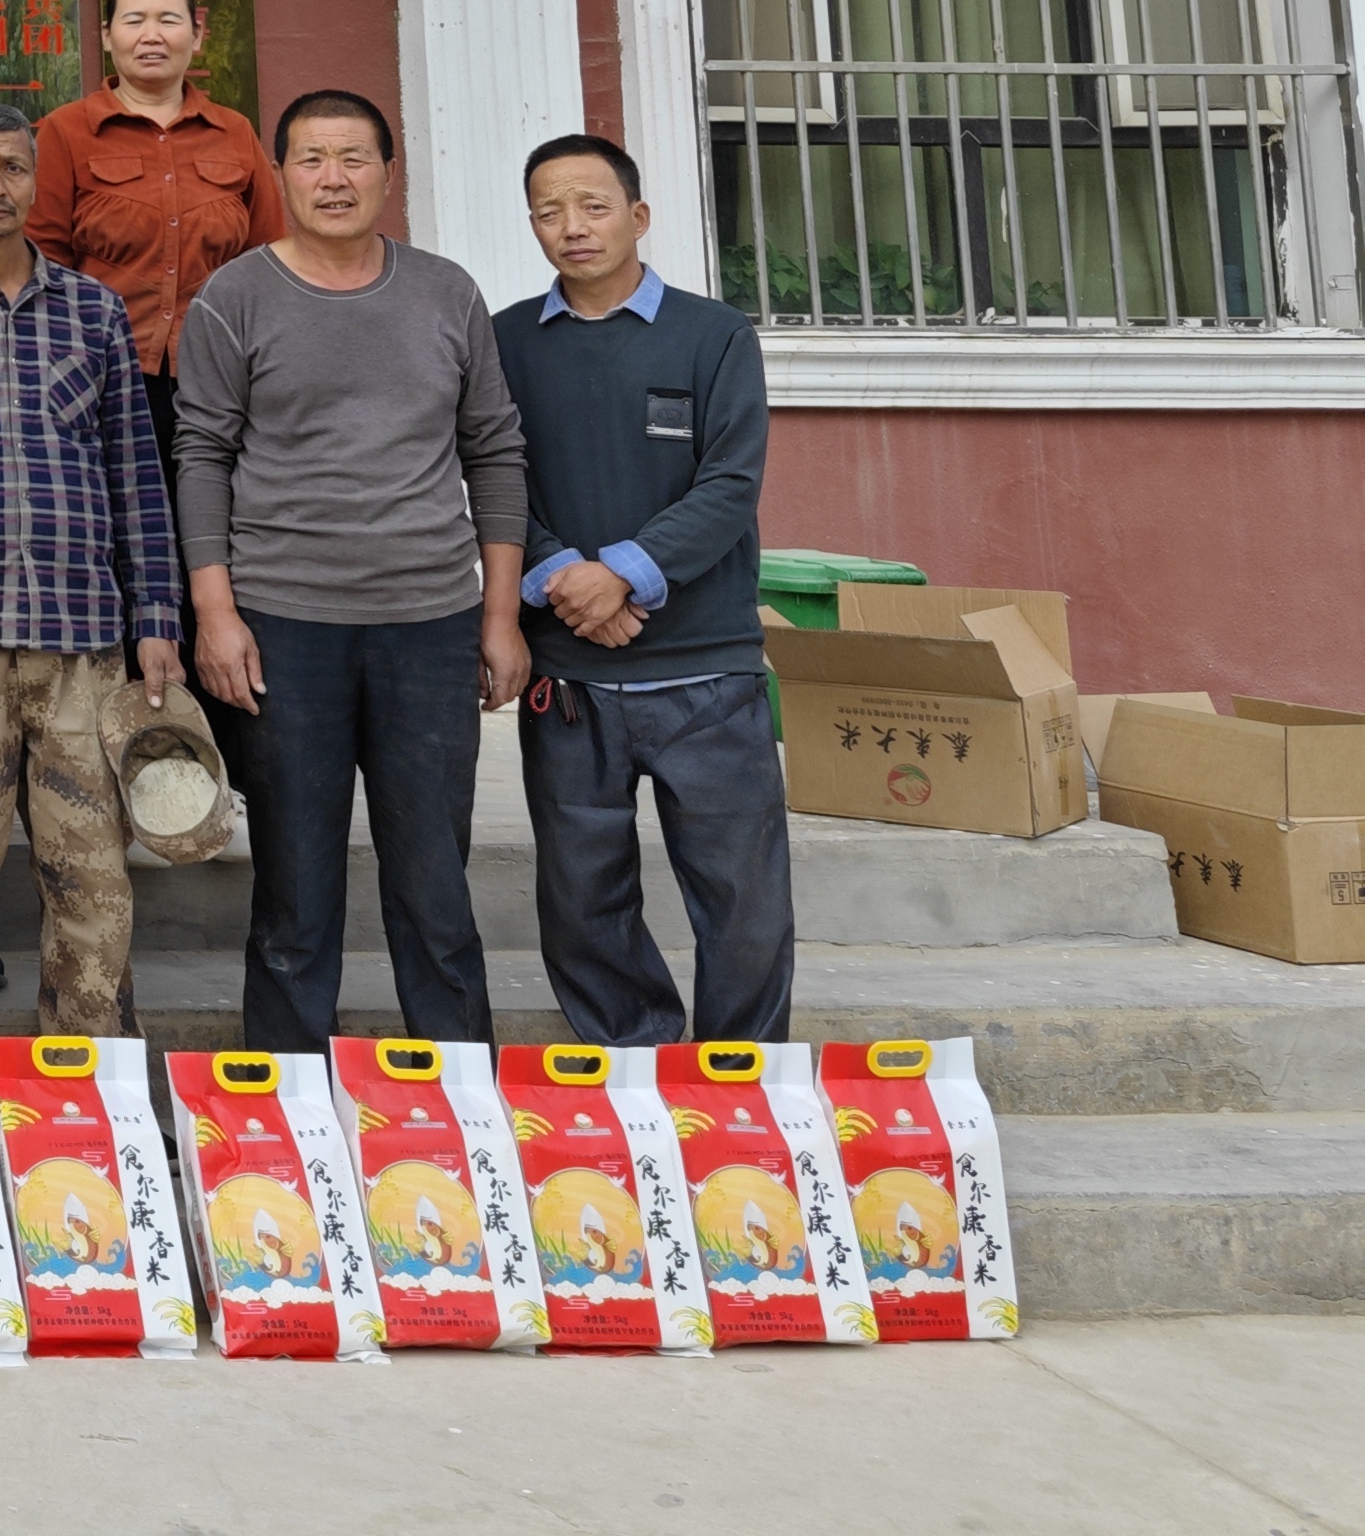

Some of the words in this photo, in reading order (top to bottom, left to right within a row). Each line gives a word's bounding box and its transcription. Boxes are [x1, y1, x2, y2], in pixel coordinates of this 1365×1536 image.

[833, 719, 973, 763] 泰来大米
[119, 1145, 174, 1284] 食尔康香米
[307, 1158, 363, 1297] 食尔康香米
[471, 1148, 527, 1287] 食尔康香米
[636, 1155, 690, 1294] 食尔康香米
[794, 1152, 851, 1290] 食尔康香米
[956, 1153, 1002, 1286] 食尔康香米
